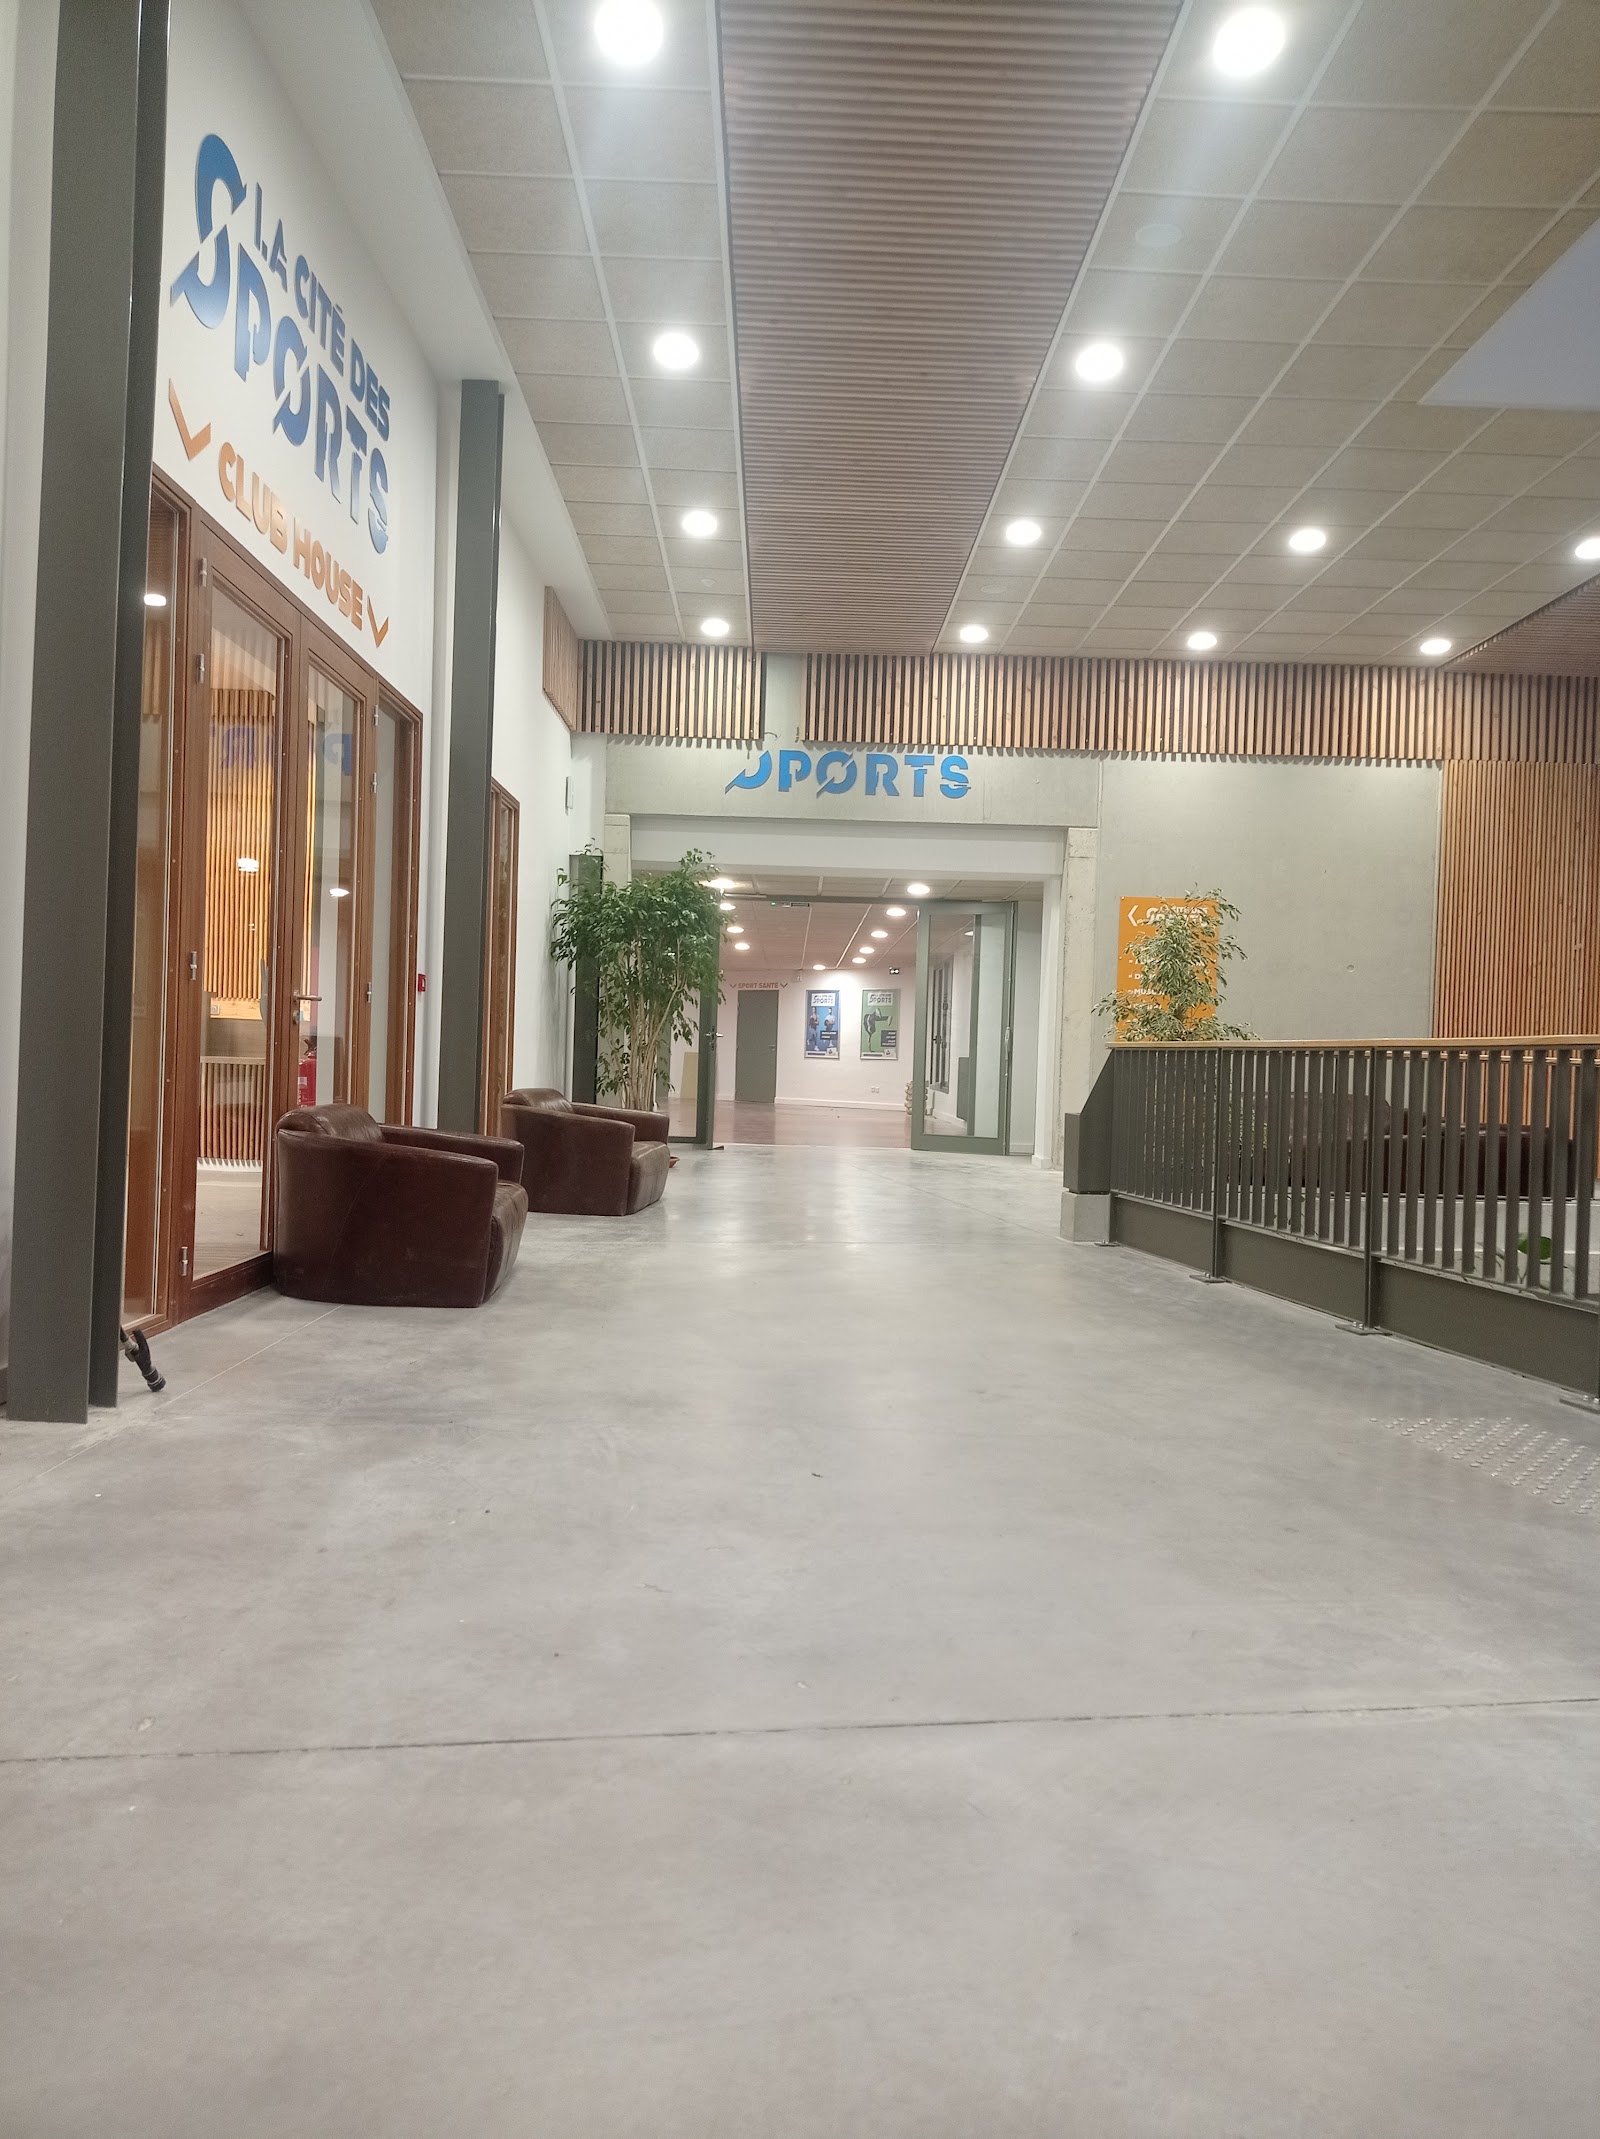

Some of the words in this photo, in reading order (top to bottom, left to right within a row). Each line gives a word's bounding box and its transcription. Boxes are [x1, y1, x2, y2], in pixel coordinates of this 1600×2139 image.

[169, 133, 391, 555] SPORTS
[253, 182, 288, 293] LA
[294, 254, 345, 377] CITÉ
[350, 337, 391, 442] DES
[217, 441, 288, 556] CLUB
[293, 527, 363, 632] HOUSE
